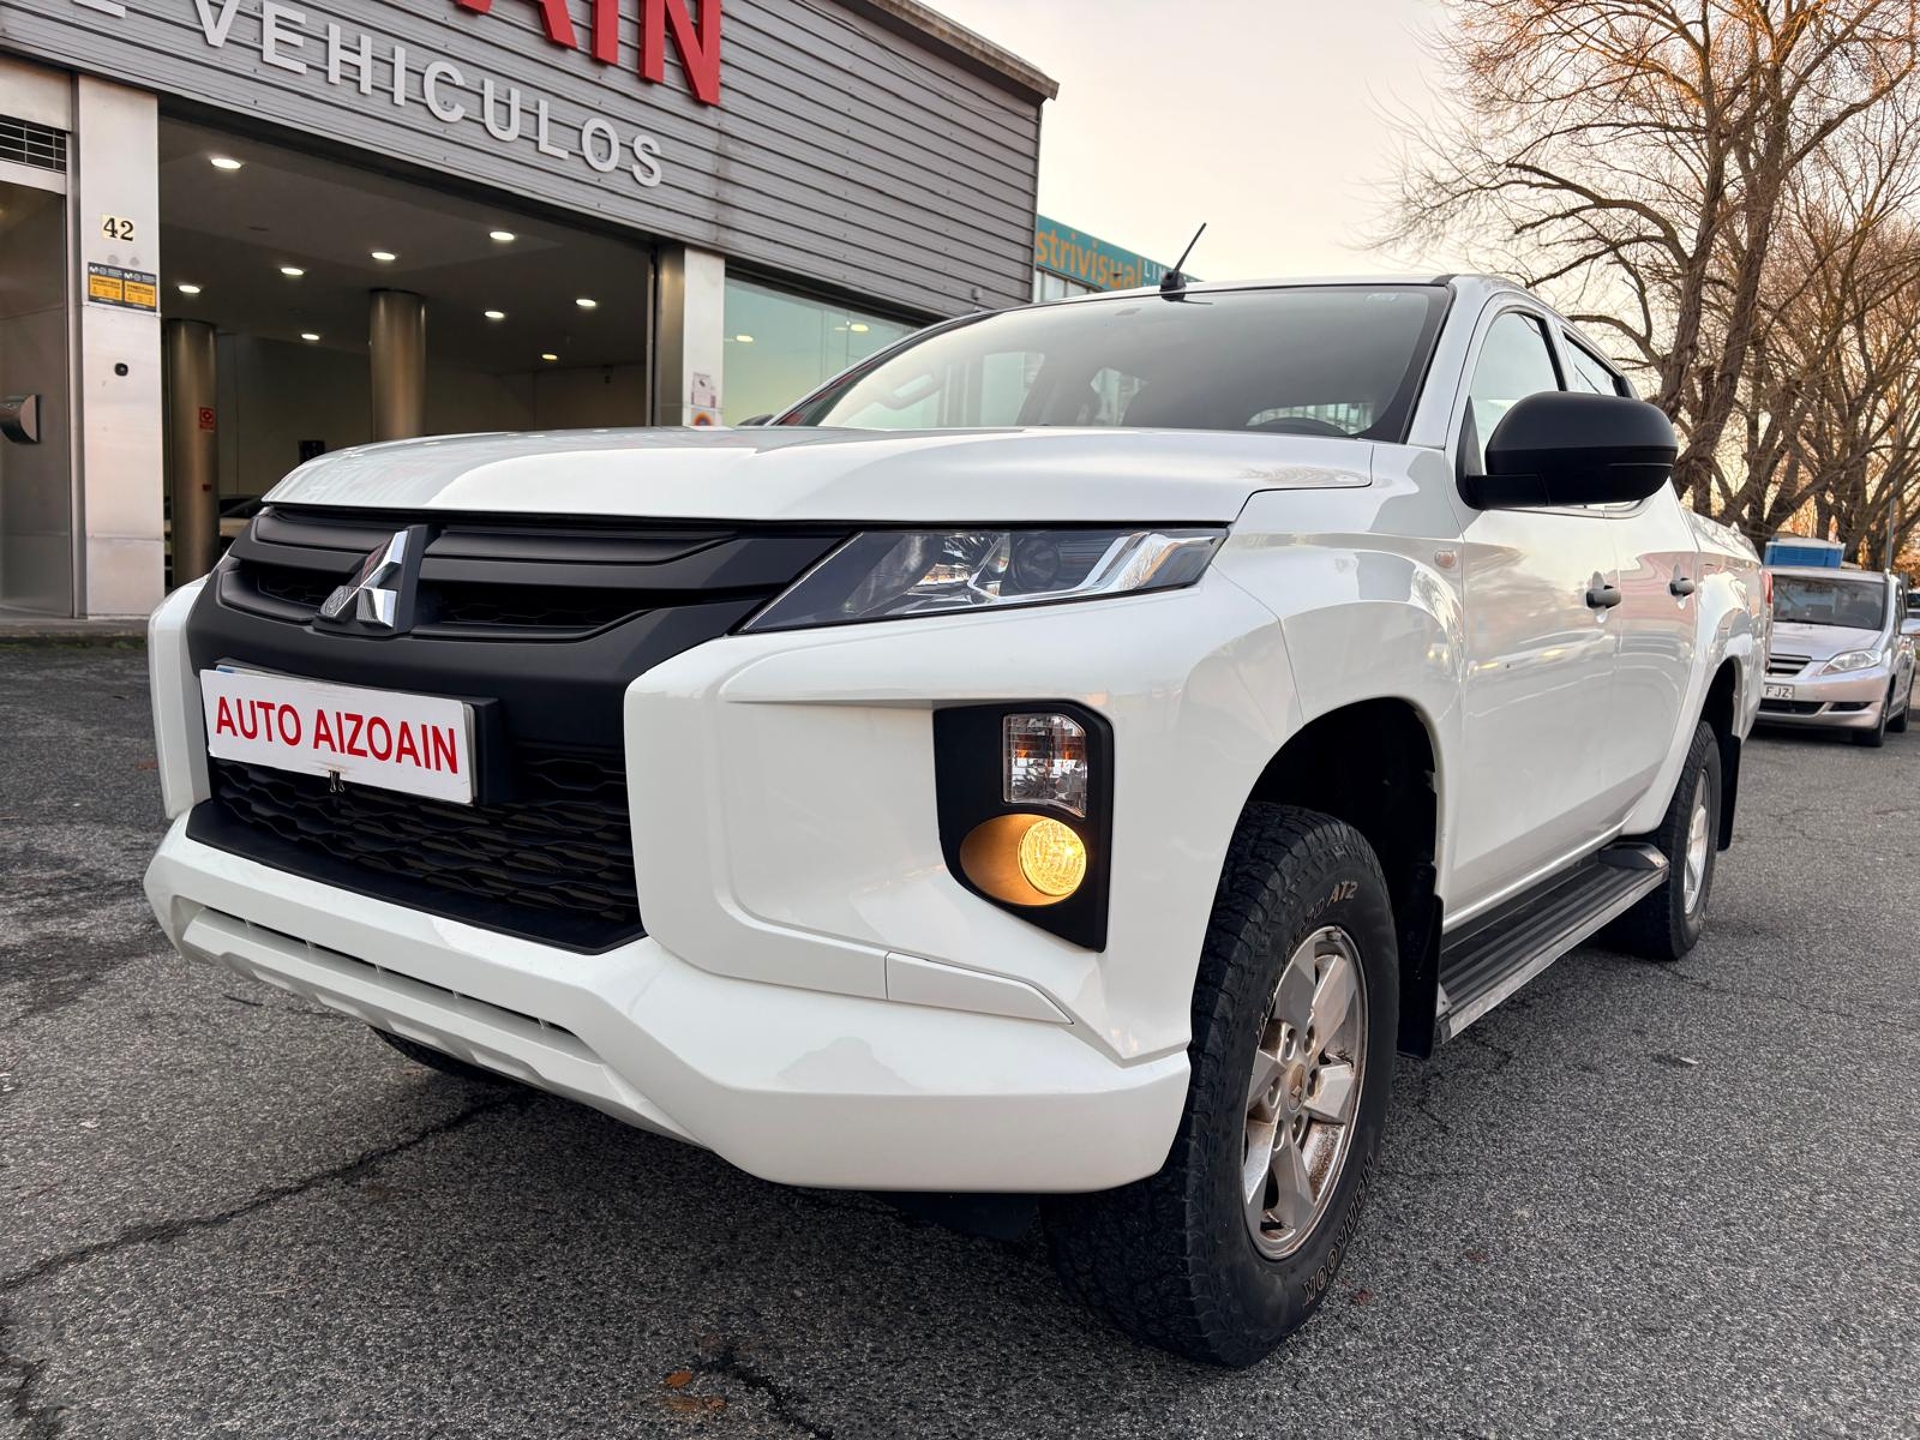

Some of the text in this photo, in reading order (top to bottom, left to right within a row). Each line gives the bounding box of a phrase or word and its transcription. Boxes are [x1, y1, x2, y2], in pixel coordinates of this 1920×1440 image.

[195, 0, 663, 188] VEHICULOS
[103, 217, 134, 241] 42
[1765, 686, 1790, 698] FJZ
[215, 696, 459, 774] AUTO AIZOAIN
